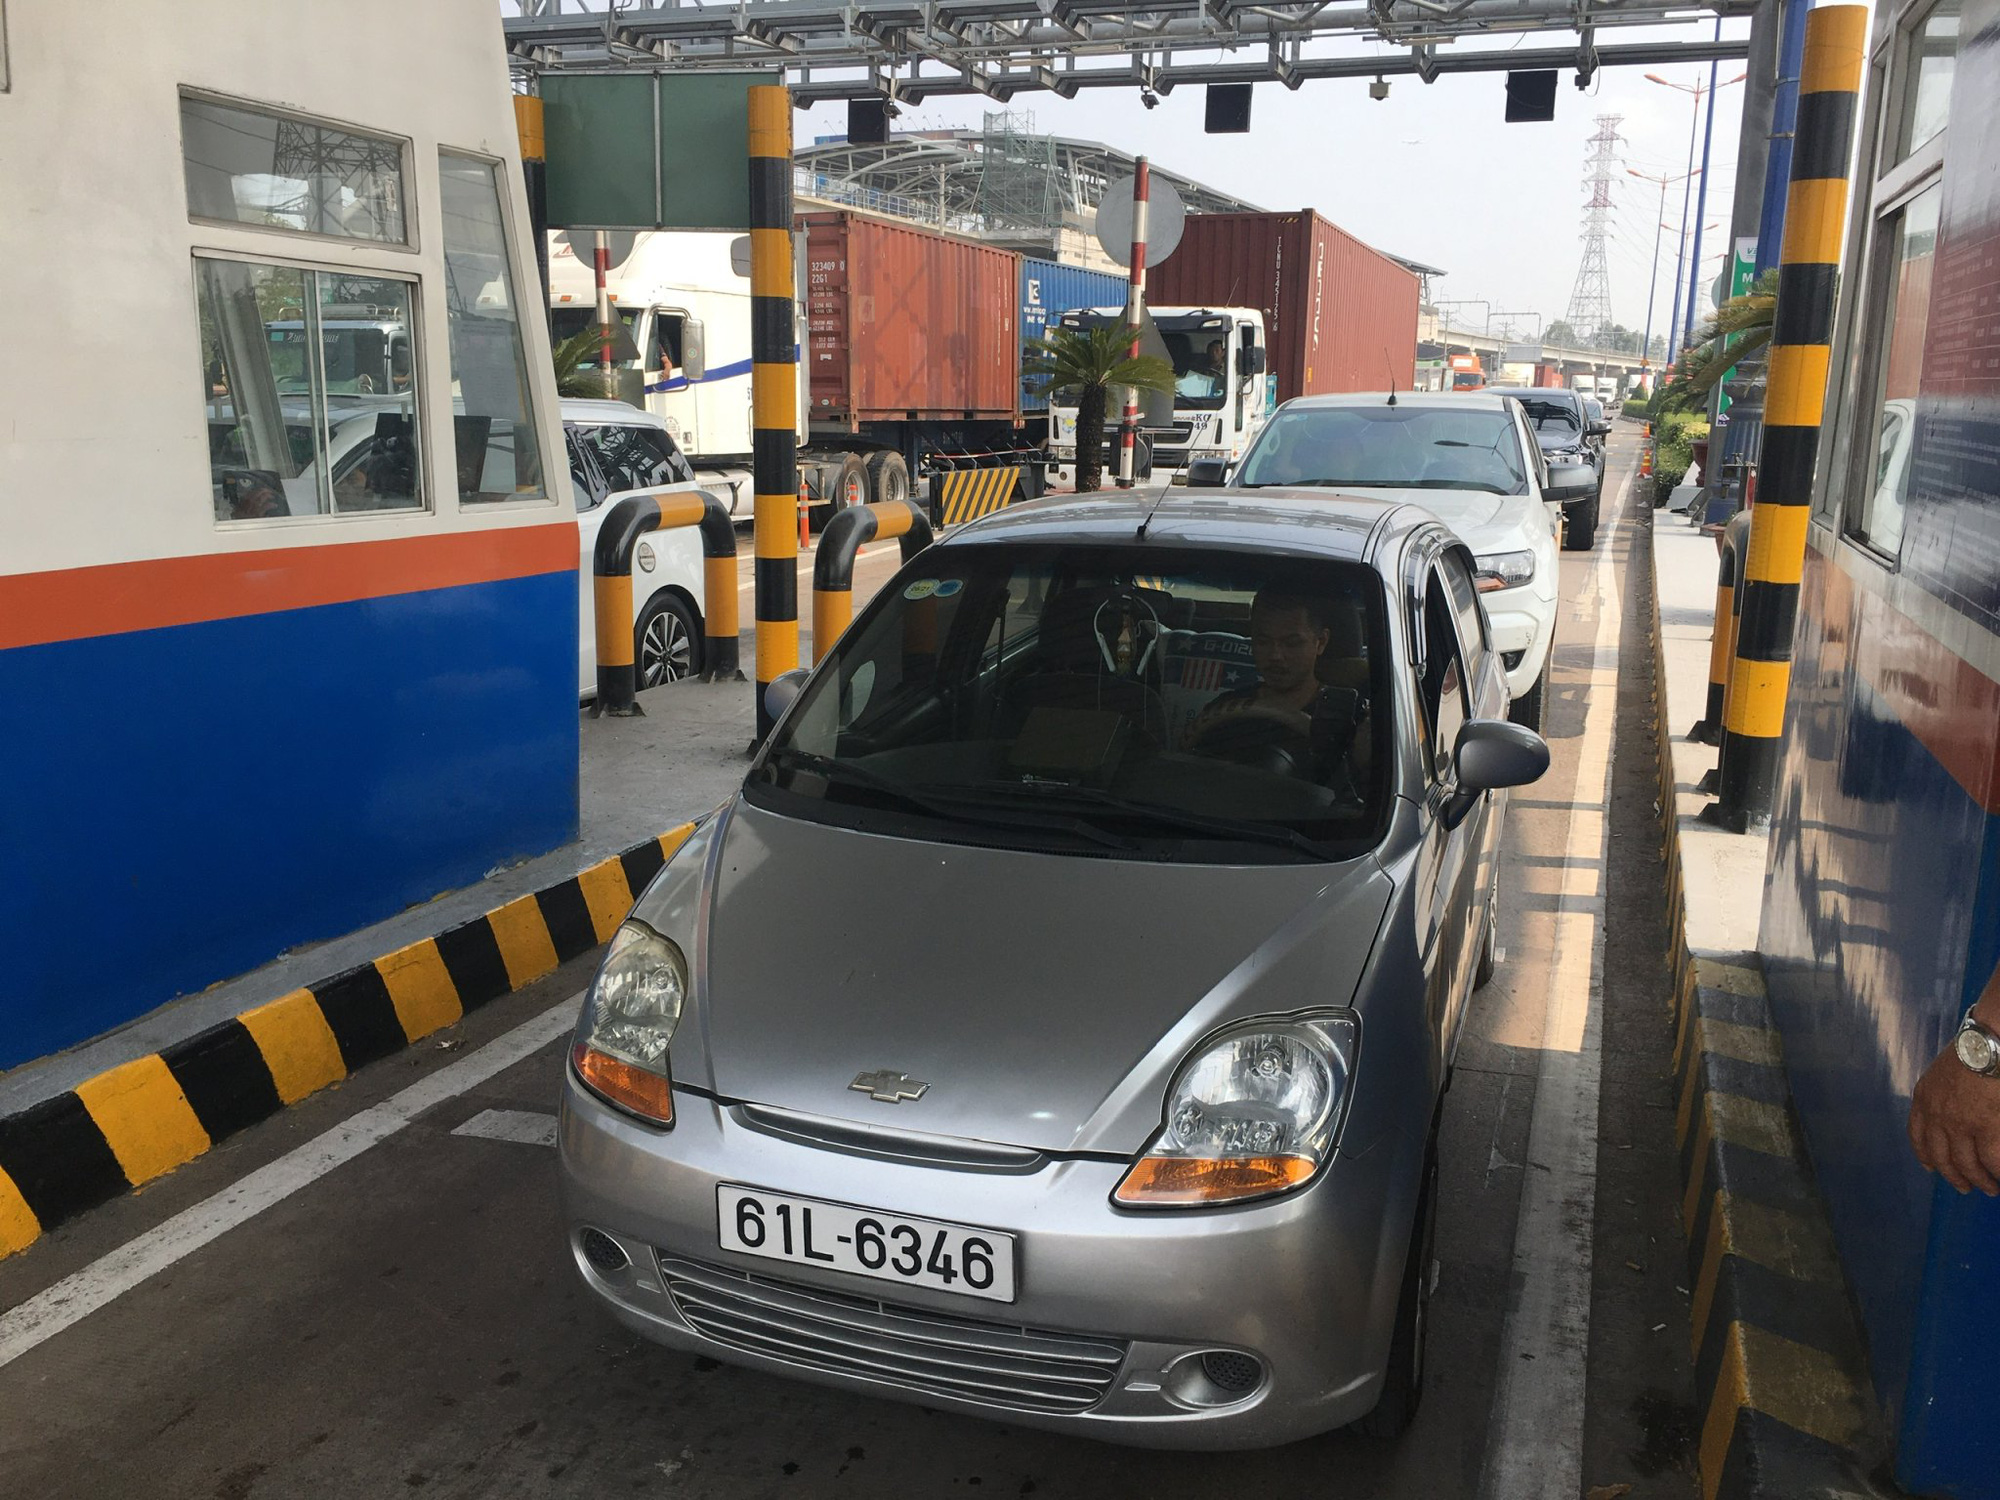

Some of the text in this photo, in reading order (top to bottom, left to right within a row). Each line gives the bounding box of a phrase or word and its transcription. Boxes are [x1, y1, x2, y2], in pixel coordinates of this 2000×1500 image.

[811, 262, 835, 272] 323409
[811, 274, 828, 284] 22G1
[1204, 640, 1253, 656] G-012
[736, 1197, 994, 1290] 61L-6346
